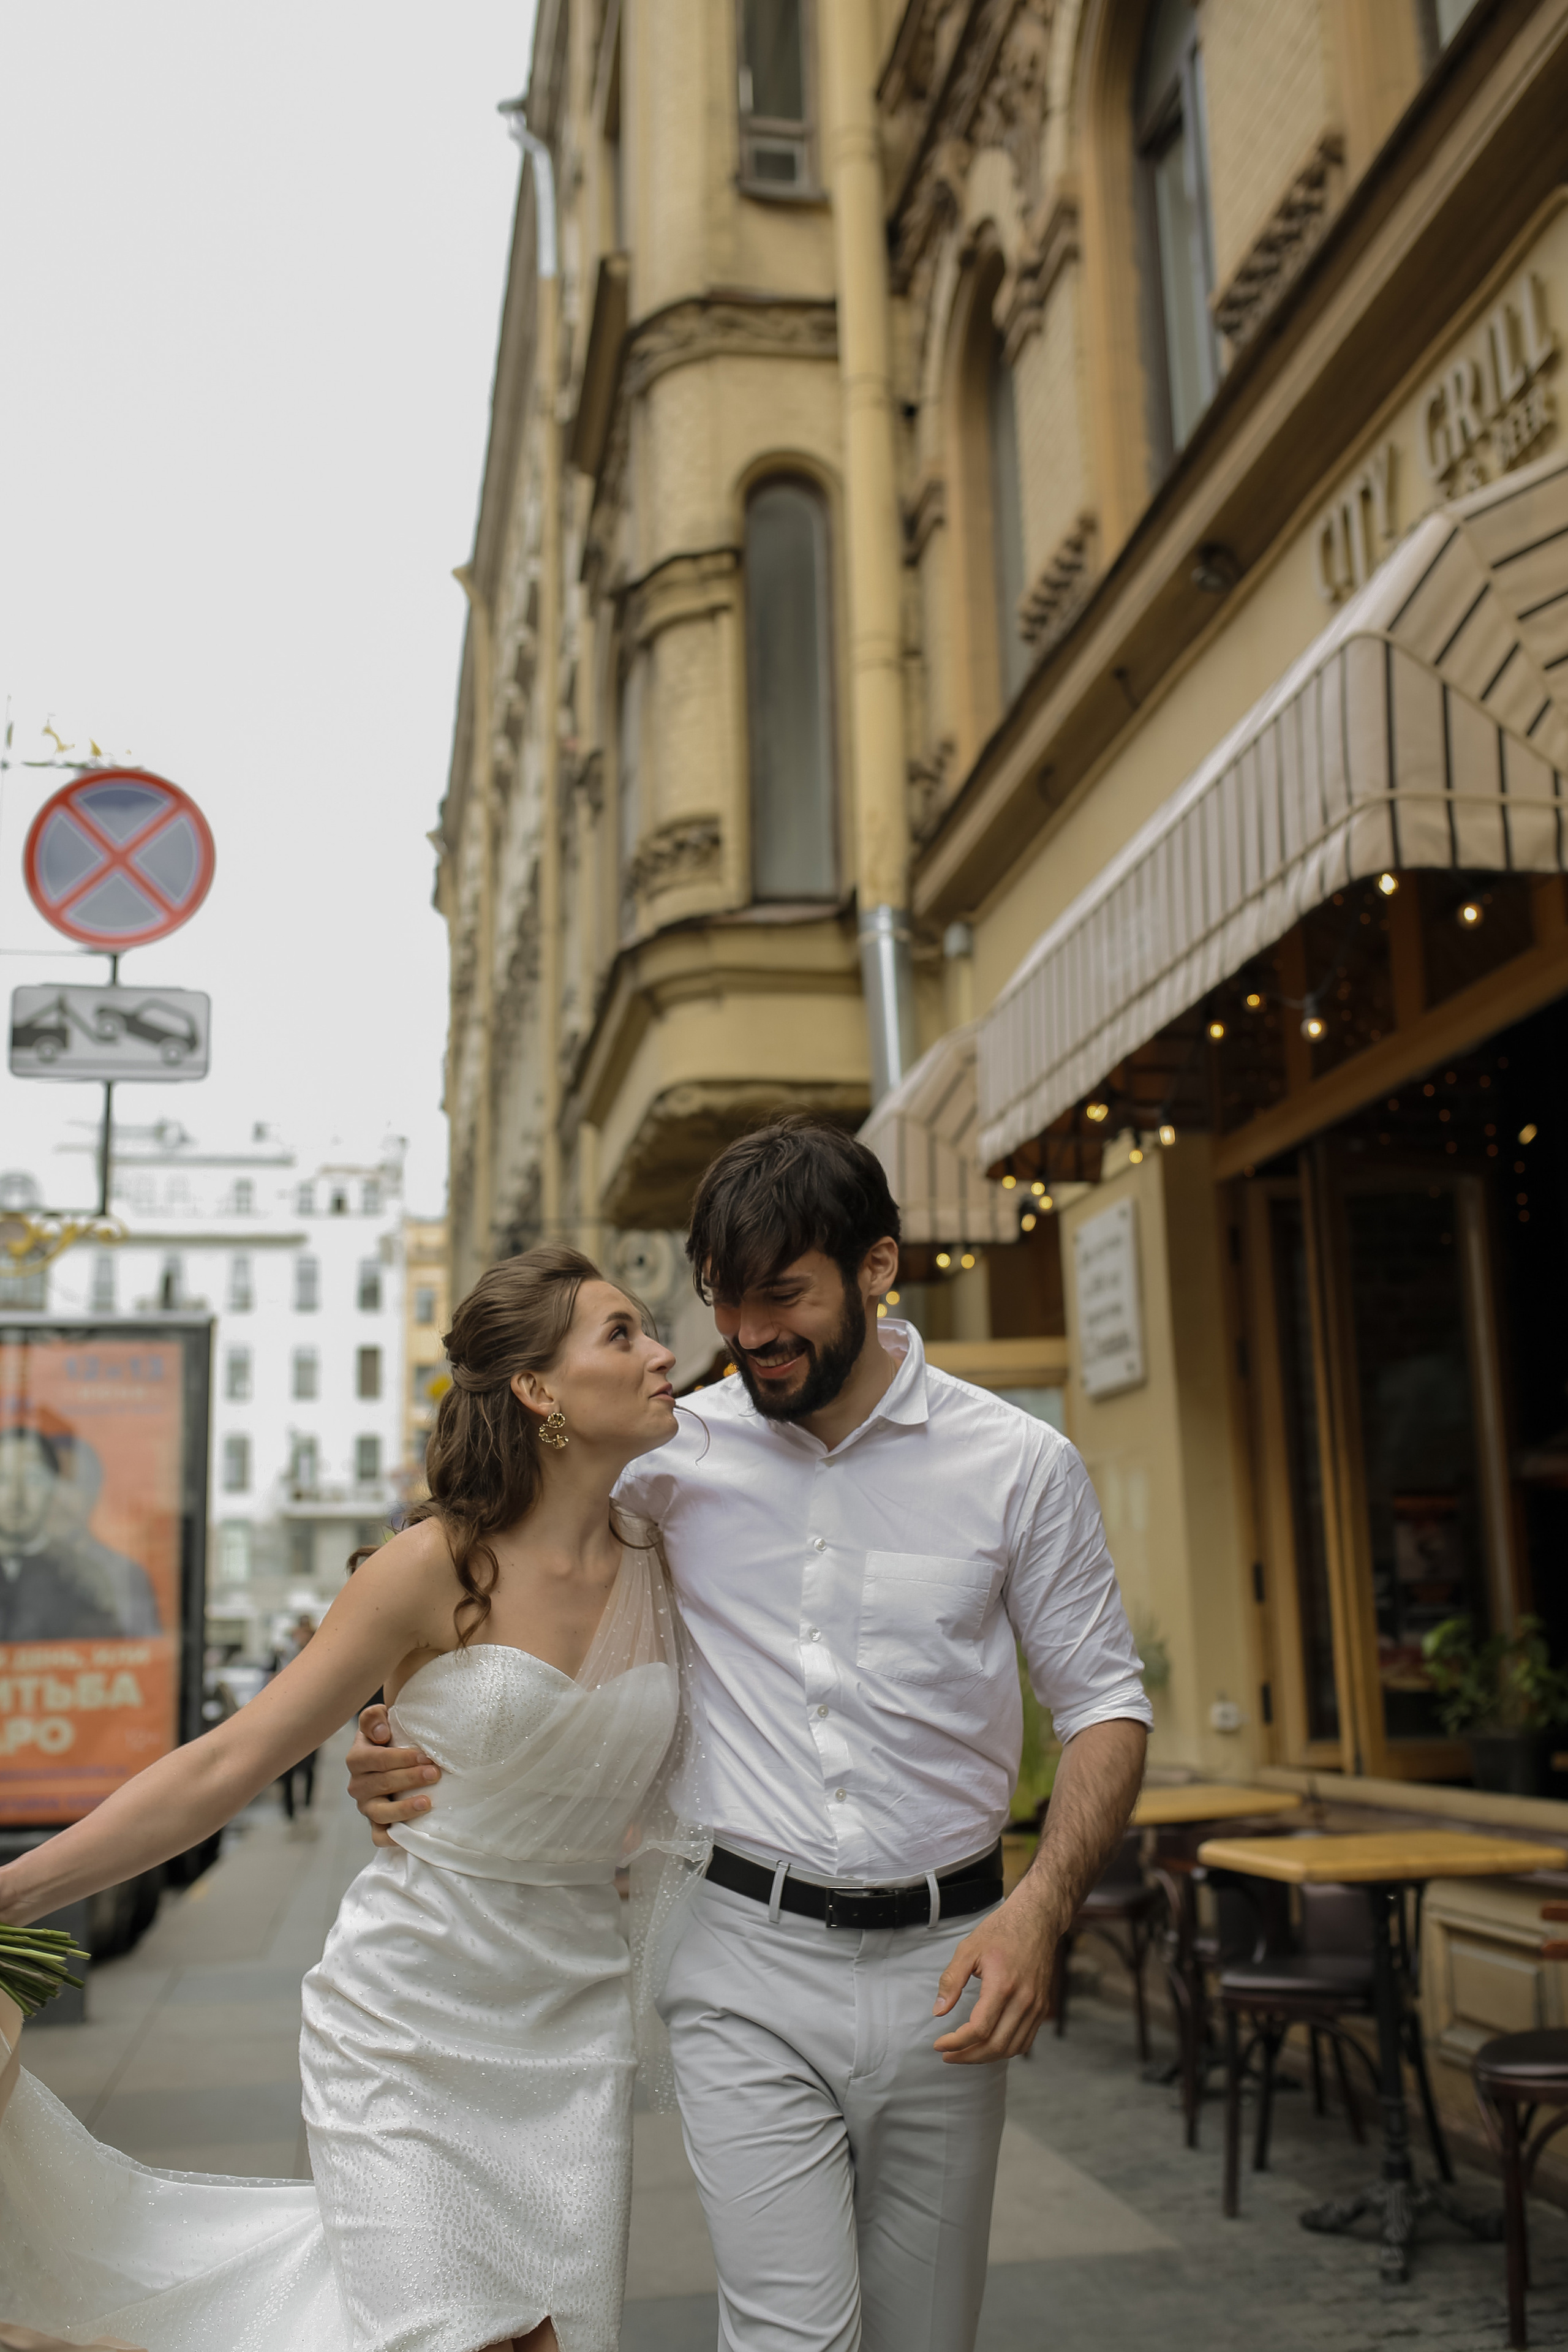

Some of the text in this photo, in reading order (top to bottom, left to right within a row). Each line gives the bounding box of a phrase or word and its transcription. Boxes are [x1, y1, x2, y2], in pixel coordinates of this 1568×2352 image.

[1313, 273, 1555, 605] CITY GRILL
[0, 1716, 75, 1757] РО
